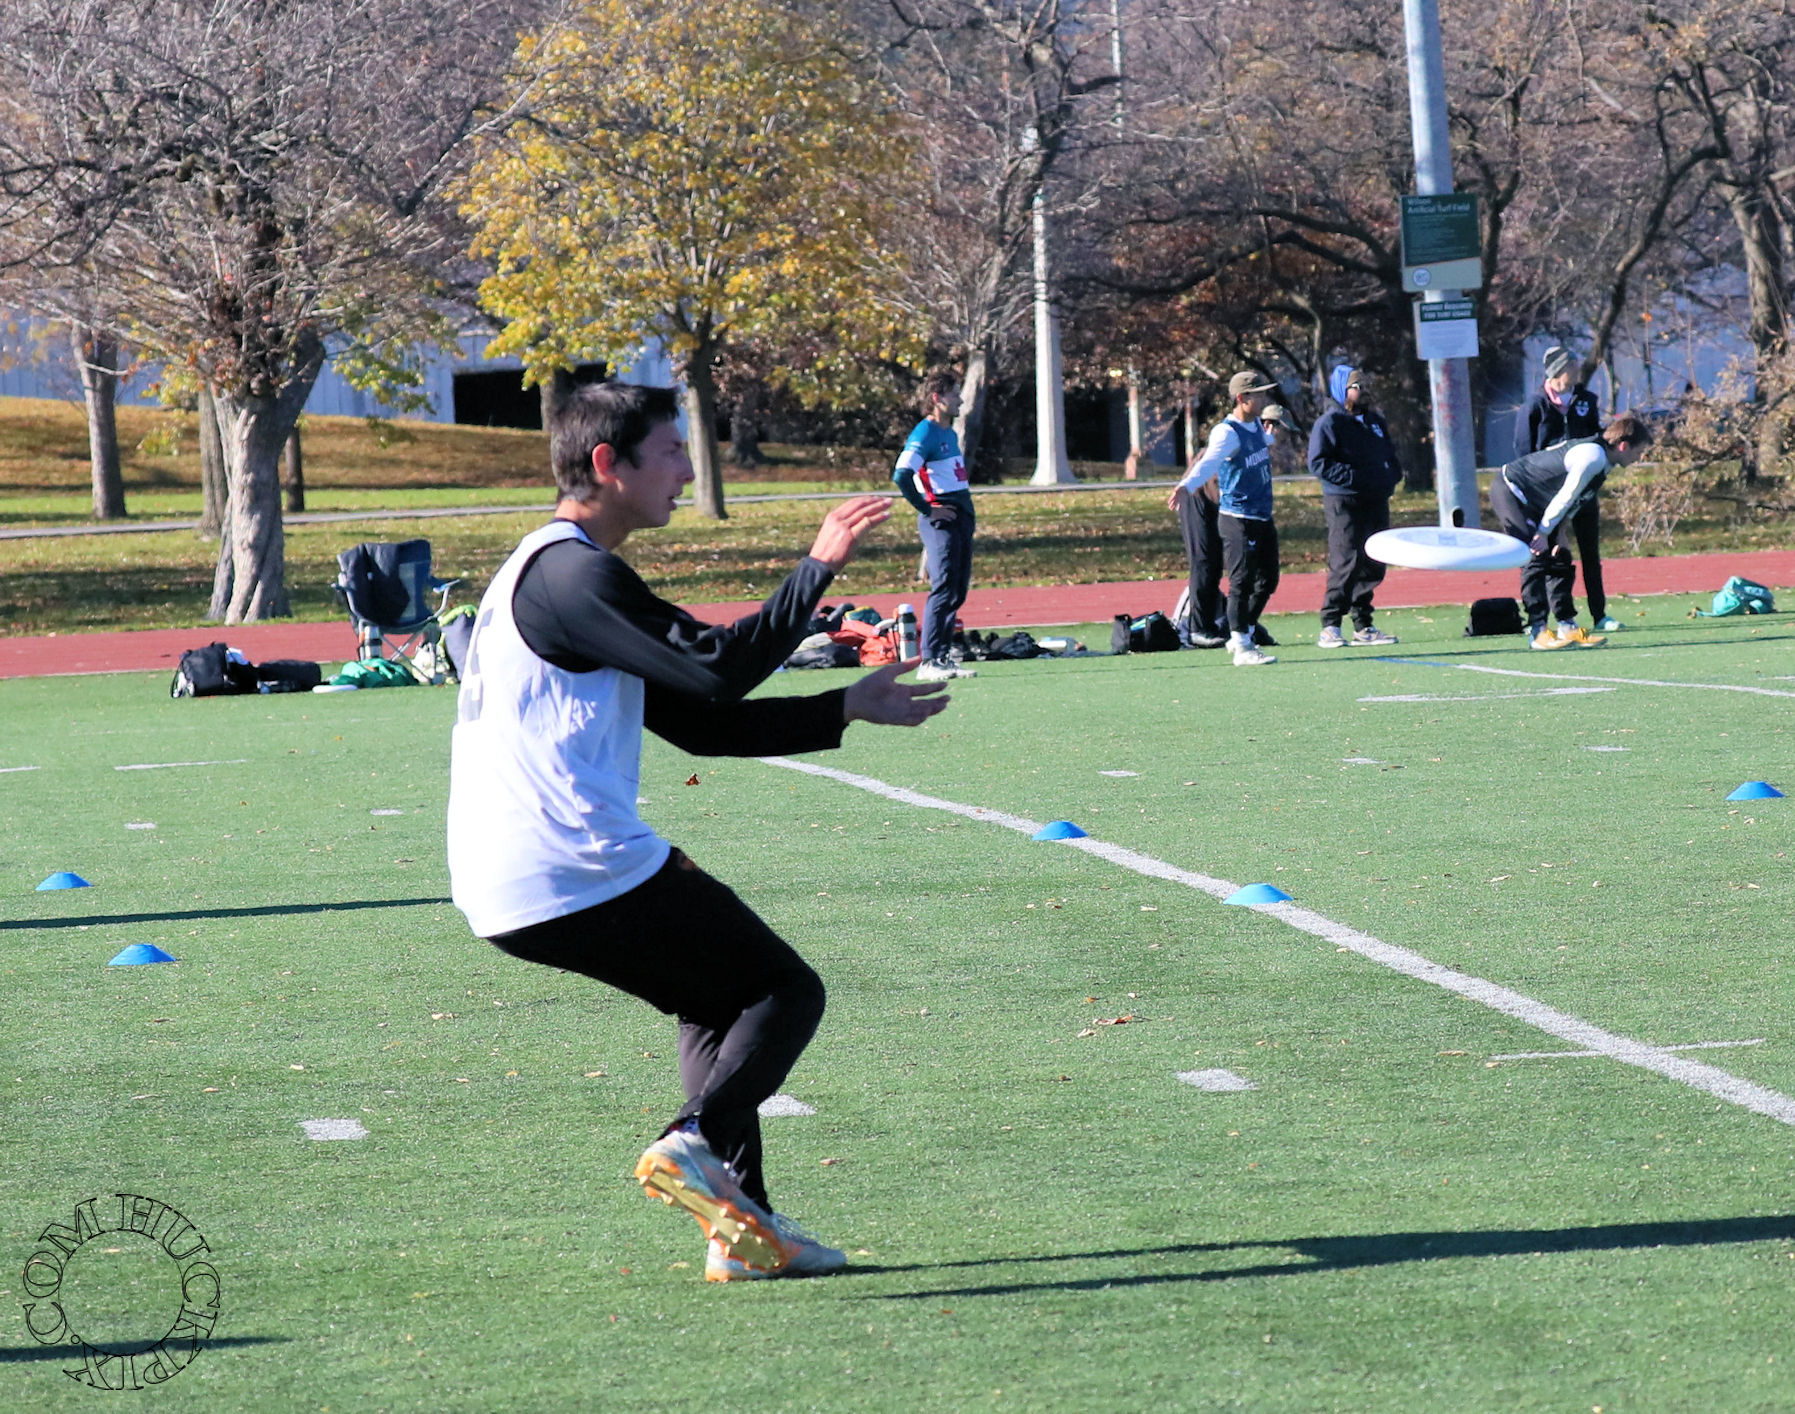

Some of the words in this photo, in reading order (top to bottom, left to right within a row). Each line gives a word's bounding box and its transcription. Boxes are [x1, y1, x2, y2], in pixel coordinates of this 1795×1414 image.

[1407, 206, 1436, 214] Artificial
[1438, 204, 1451, 213] Turf
[1453, 203, 1471, 211] Field
